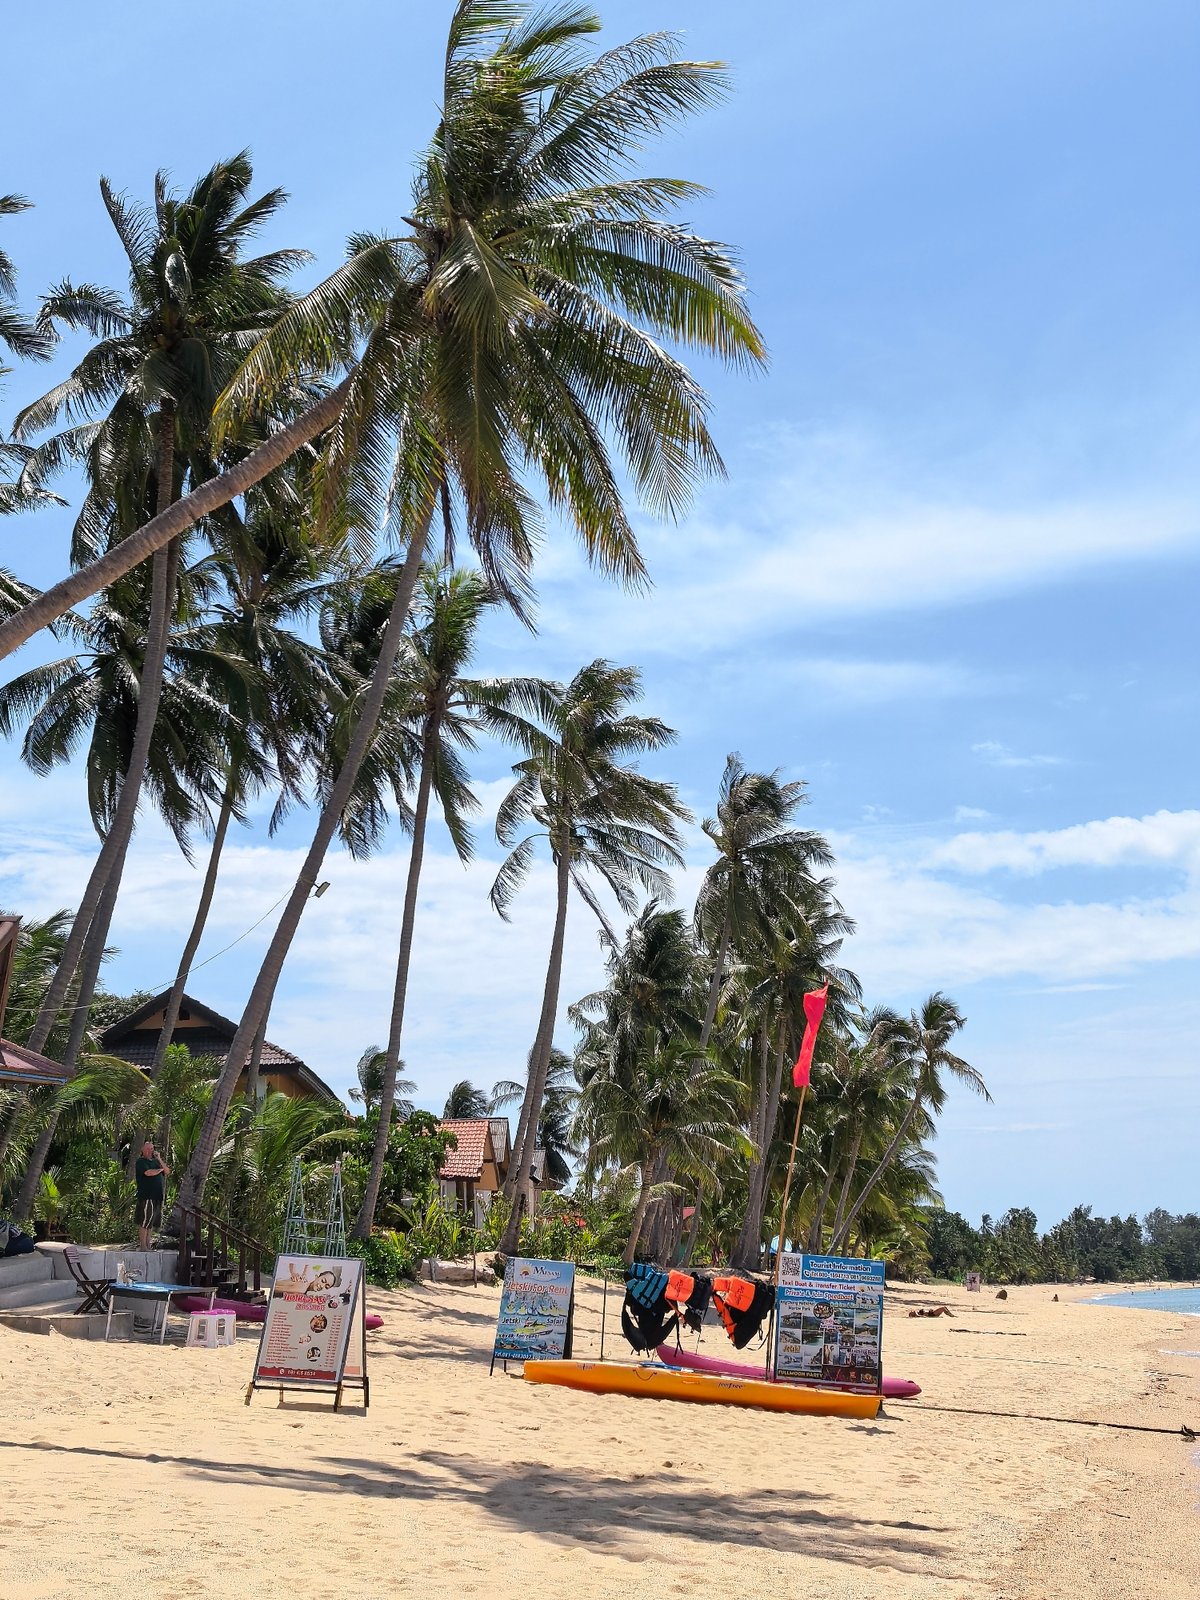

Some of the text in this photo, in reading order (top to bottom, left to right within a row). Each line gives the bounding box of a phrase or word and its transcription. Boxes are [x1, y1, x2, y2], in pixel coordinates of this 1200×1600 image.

[809, 1260, 871, 1272] Tourist Information
[548, 1284, 568, 1295] Rent
[815, 1281, 838, 1290] Transfer
[839, 1283, 856, 1291] Ticket
[785, 1289, 805, 1297] Private
[824, 1291, 853, 1300] Speedboat
